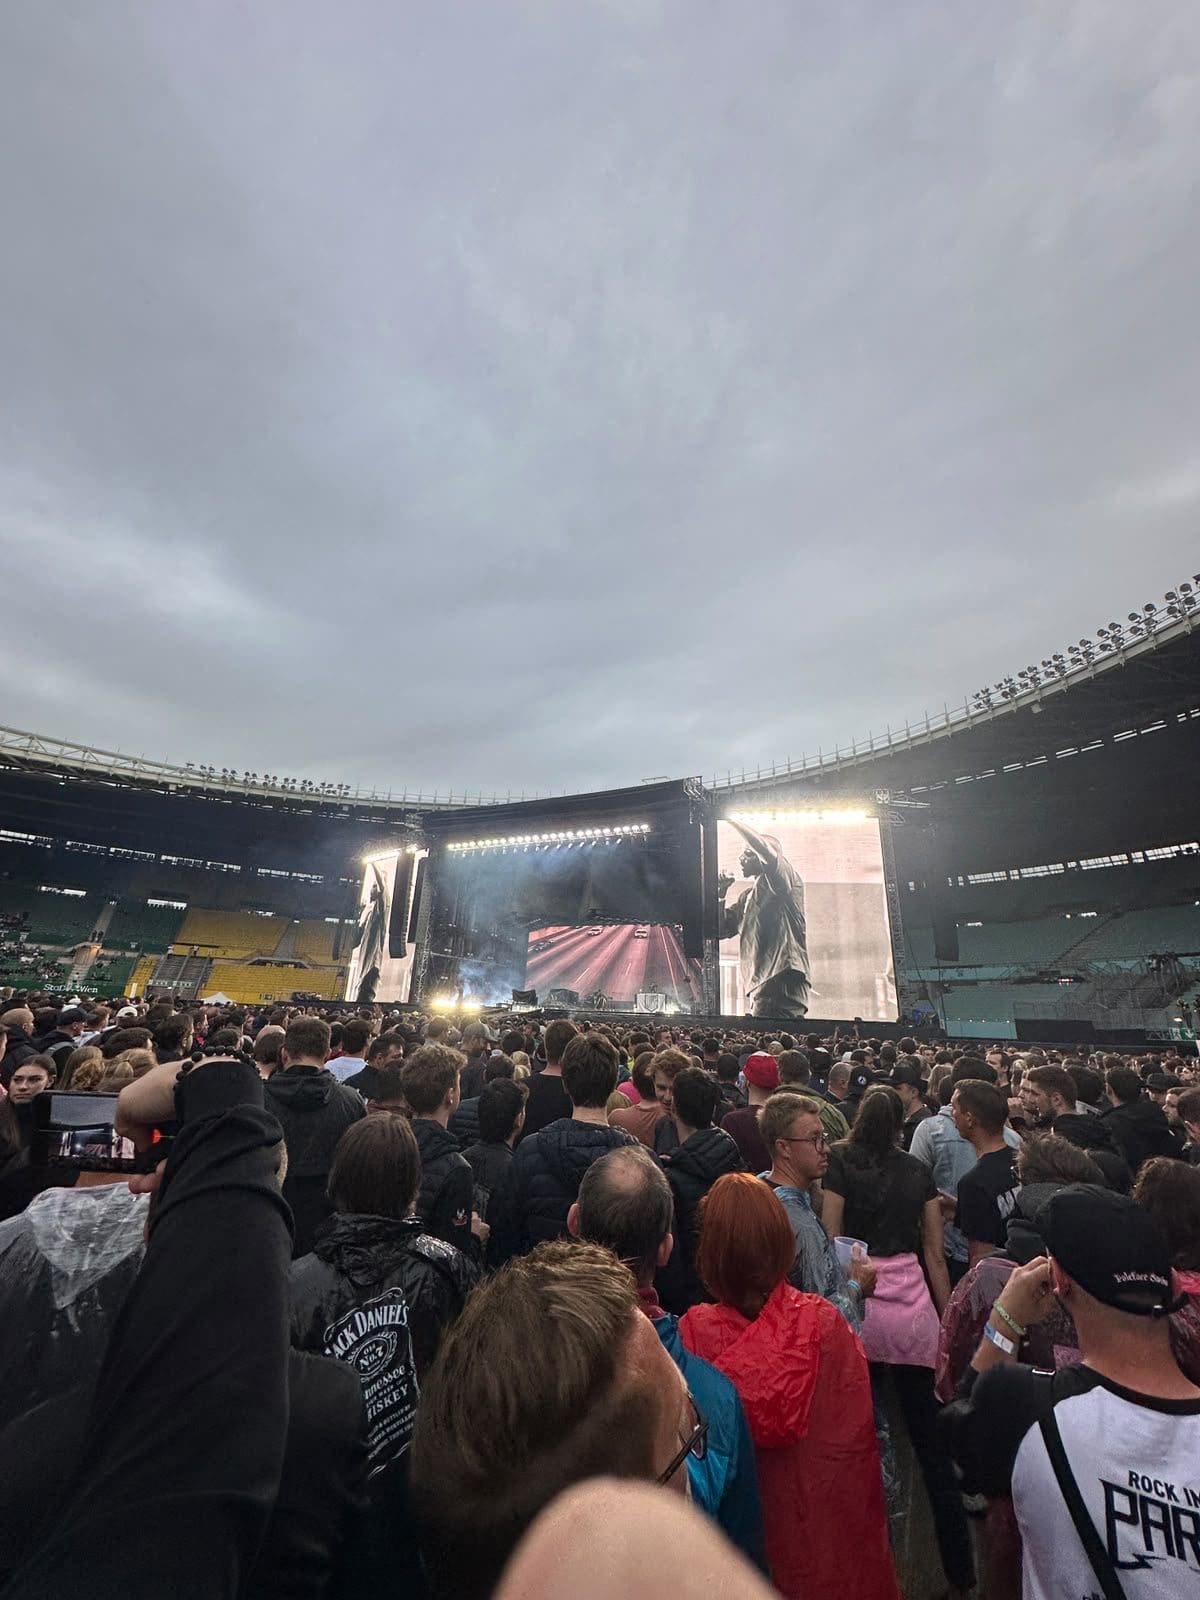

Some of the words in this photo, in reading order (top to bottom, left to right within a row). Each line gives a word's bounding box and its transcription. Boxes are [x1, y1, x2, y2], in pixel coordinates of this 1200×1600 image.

[79, 985, 98, 993] Wien
[325, 1323, 359, 1360] ACK
[354, 1299, 410, 1337] DANIEL'S
[1128, 1470, 1180, 1503] ROCK
